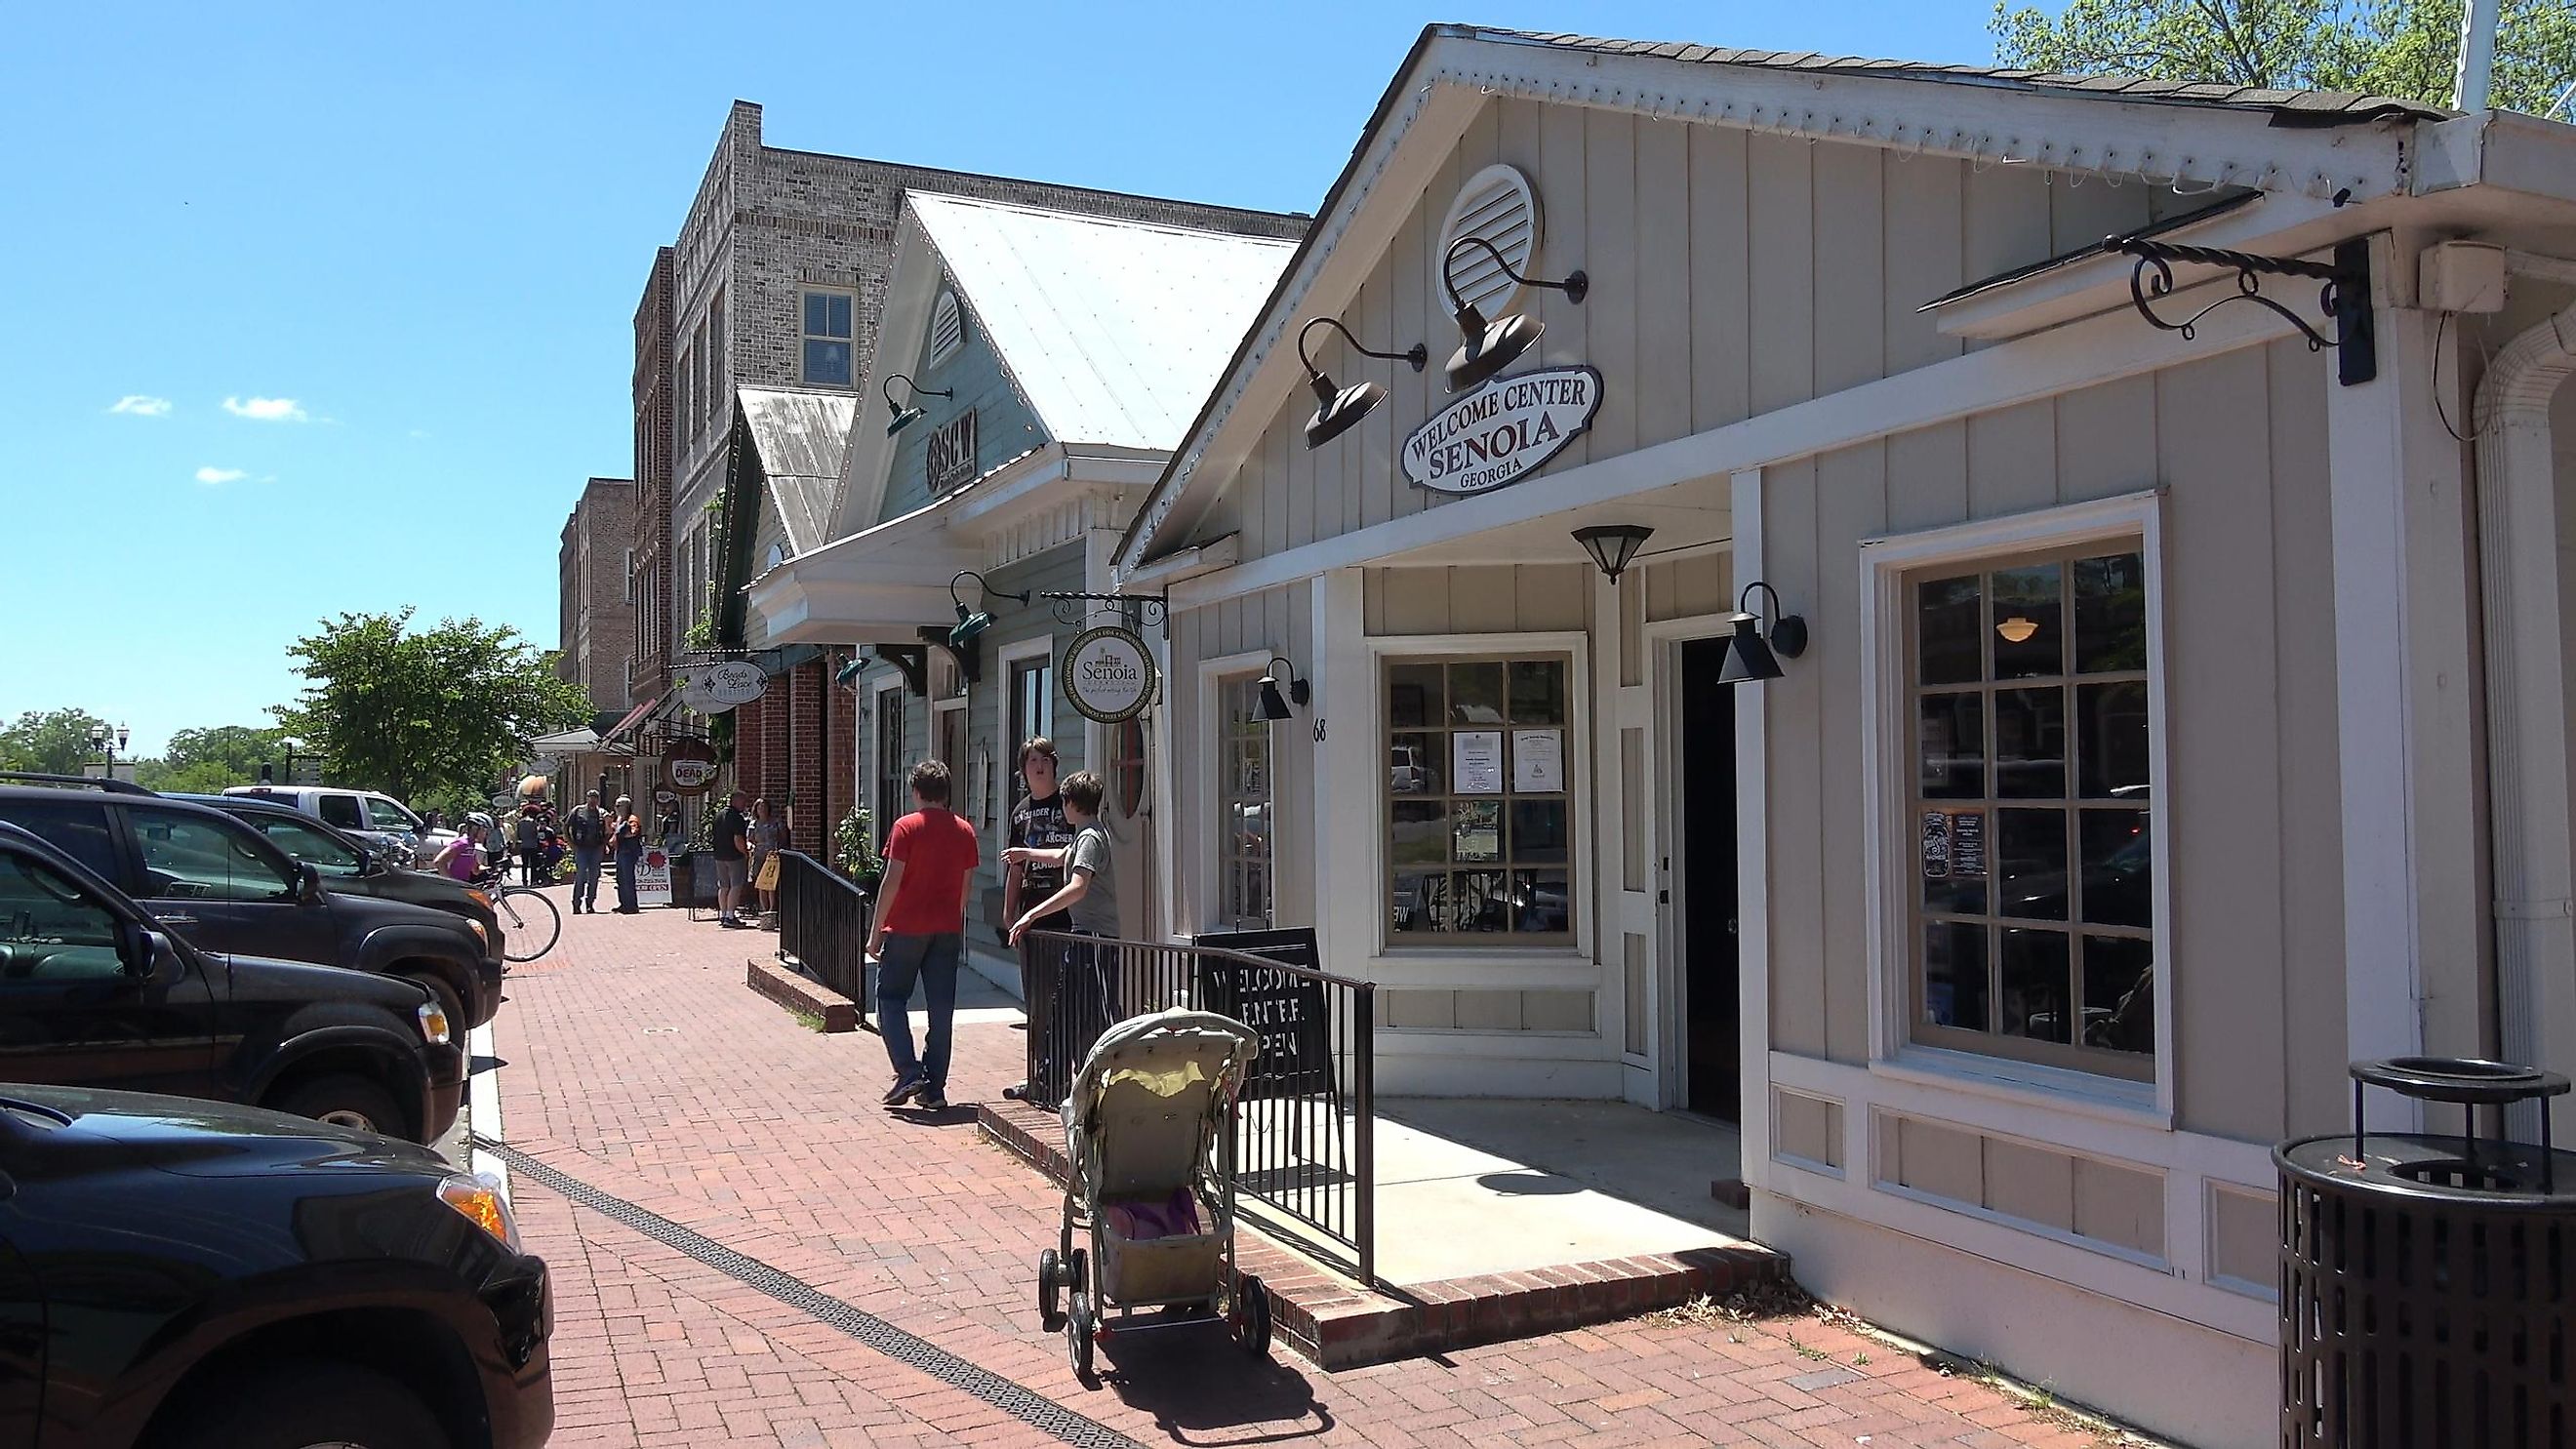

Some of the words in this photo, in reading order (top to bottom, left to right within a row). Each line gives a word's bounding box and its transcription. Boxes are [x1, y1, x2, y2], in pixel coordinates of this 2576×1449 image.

[1411, 391, 1499, 463] WELCOME
[1504, 379, 1587, 410] CENTER
[1429, 410, 1560, 480] SENOIA
[1460, 458, 1523, 488] GEORGIA
[1082, 661, 1138, 680] Senoia
[1312, 717, 1326, 743] 68
[675, 768, 703, 778] DEAD
[1045, 833, 1073, 844] ARCHER
